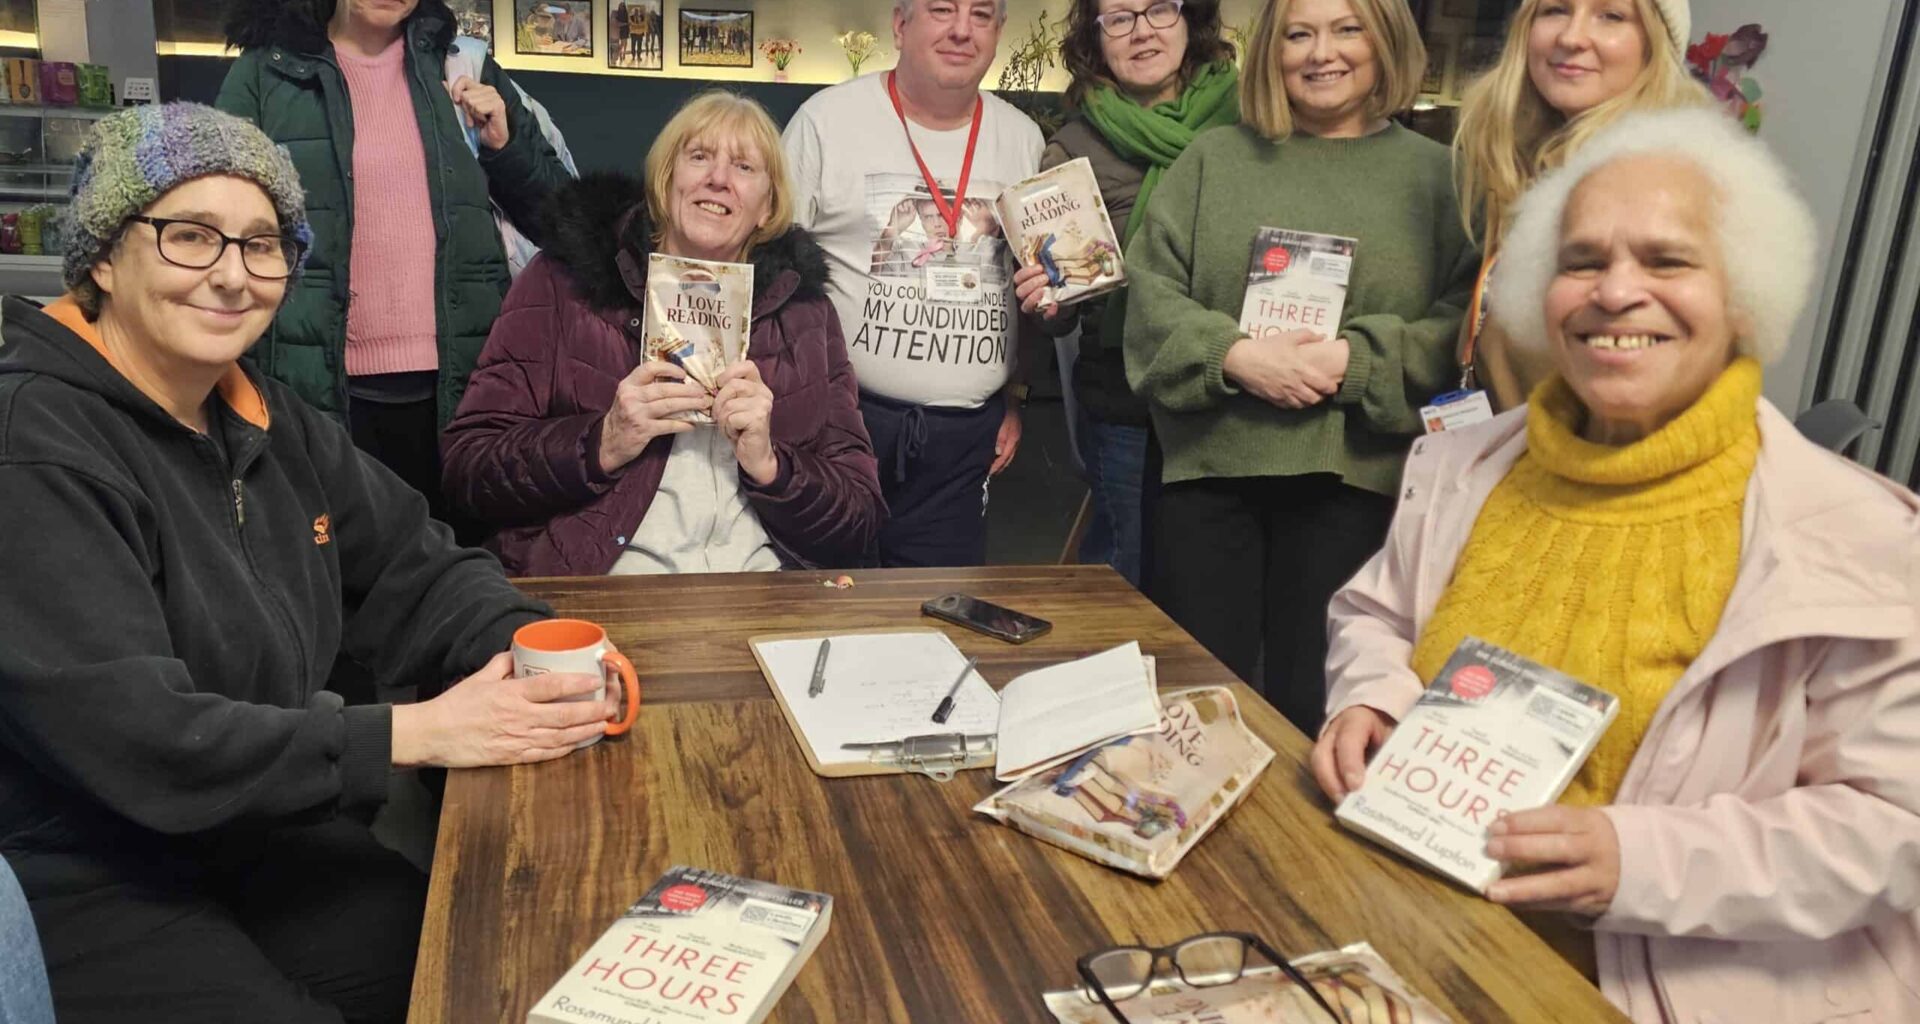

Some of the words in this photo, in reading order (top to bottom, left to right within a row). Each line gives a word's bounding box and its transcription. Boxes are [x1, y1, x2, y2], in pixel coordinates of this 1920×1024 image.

[1020, 200, 1081, 230] READING
[1023, 205, 1030, 216] I
[1034, 191, 1071, 213] LOVE
[676, 293, 681, 307] I
[688, 295, 726, 315] LOVE
[868, 282, 893, 298] YOU
[983, 292, 1007, 307] NDLE
[1259, 299, 1327, 326] THREE
[667, 308, 732, 330] READING
[863, 297, 896, 323] MY
[903, 304, 1009, 333] UNDIVIDED
[852, 322, 1008, 365] ATTENTION
[1159, 715, 1204, 766] DING
[1166, 704, 1202, 750] OVE
[1412, 726, 1526, 798] THREE
[1352, 795, 1429, 842] Rosamund
[1425, 831, 1477, 871] Lupton
[623, 934, 753, 984] THREE
[581, 958, 745, 1015] HOURS
[552, 995, 651, 1024] Rosamu
